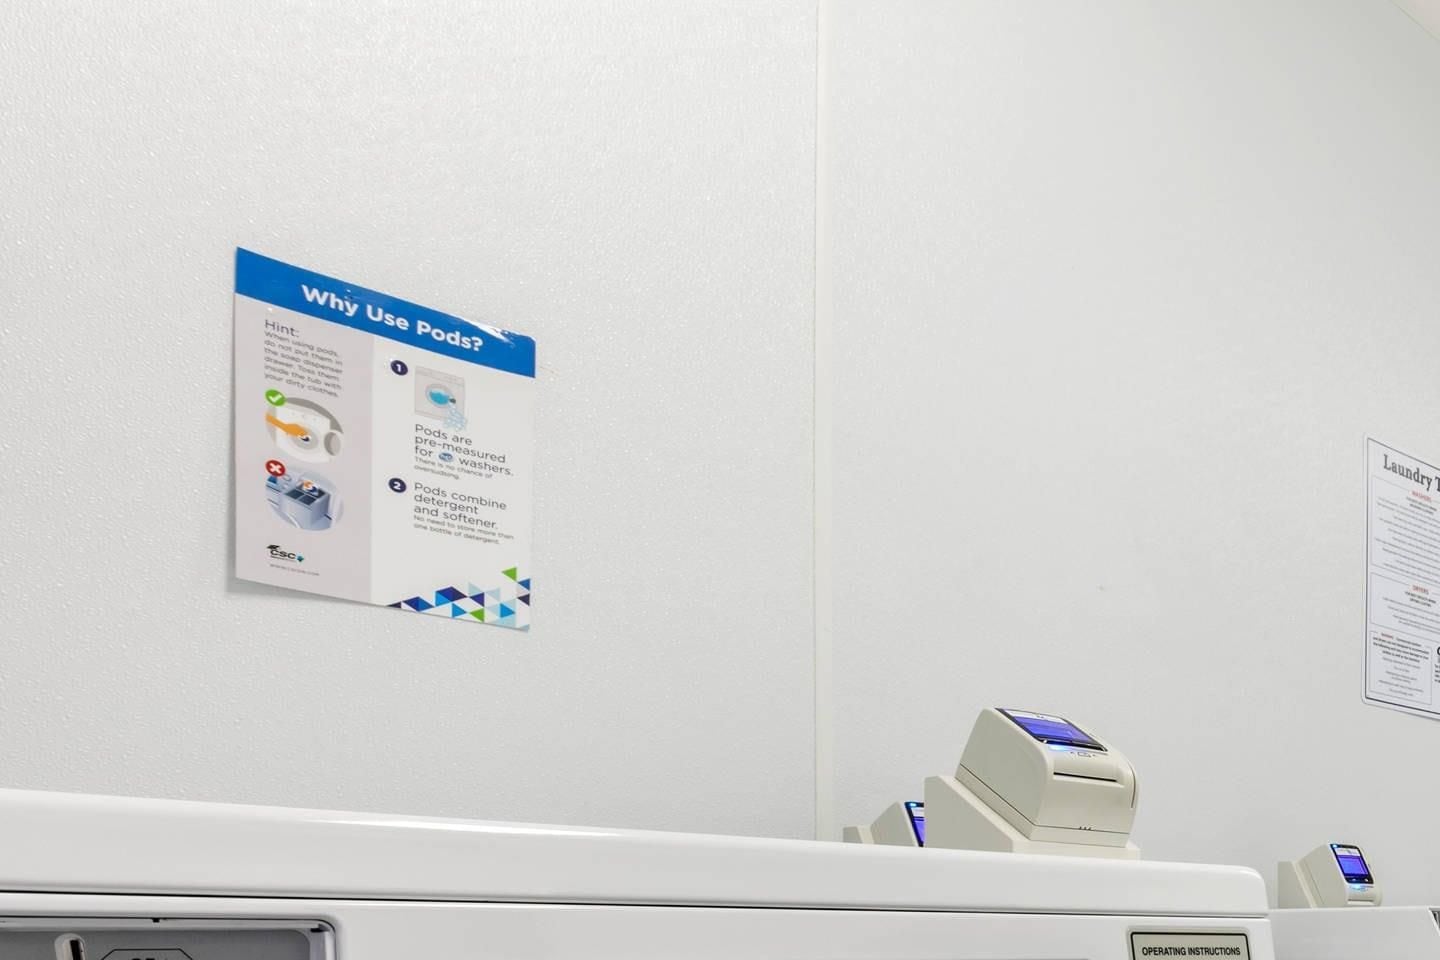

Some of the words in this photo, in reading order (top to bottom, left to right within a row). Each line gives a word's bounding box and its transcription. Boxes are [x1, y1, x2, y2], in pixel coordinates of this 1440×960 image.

[265, 319, 299, 337] Hint:
[301, 284, 358, 317] Why
[366, 304, 409, 331] Use
[416, 320, 483, 352] Pods?
[415, 423, 448, 440] Pods
[451, 435, 473, 446] are
[415, 436, 506, 463] pre-measured
[415, 445, 433, 457] for
[458, 457, 514, 476] washers.
[1383, 453, 1433, 492] Laundry
[414, 482, 448, 498] Pods
[451, 491, 507, 510] combine
[414, 493, 479, 515] detergent
[414, 505, 439, 517] and
[443, 511, 498, 530] softener.
[270, 549, 296, 560] CSC
[1141, 946, 1187, 956] OPERATING
[1187, 946, 1241, 956] INSTRUCTIONS
